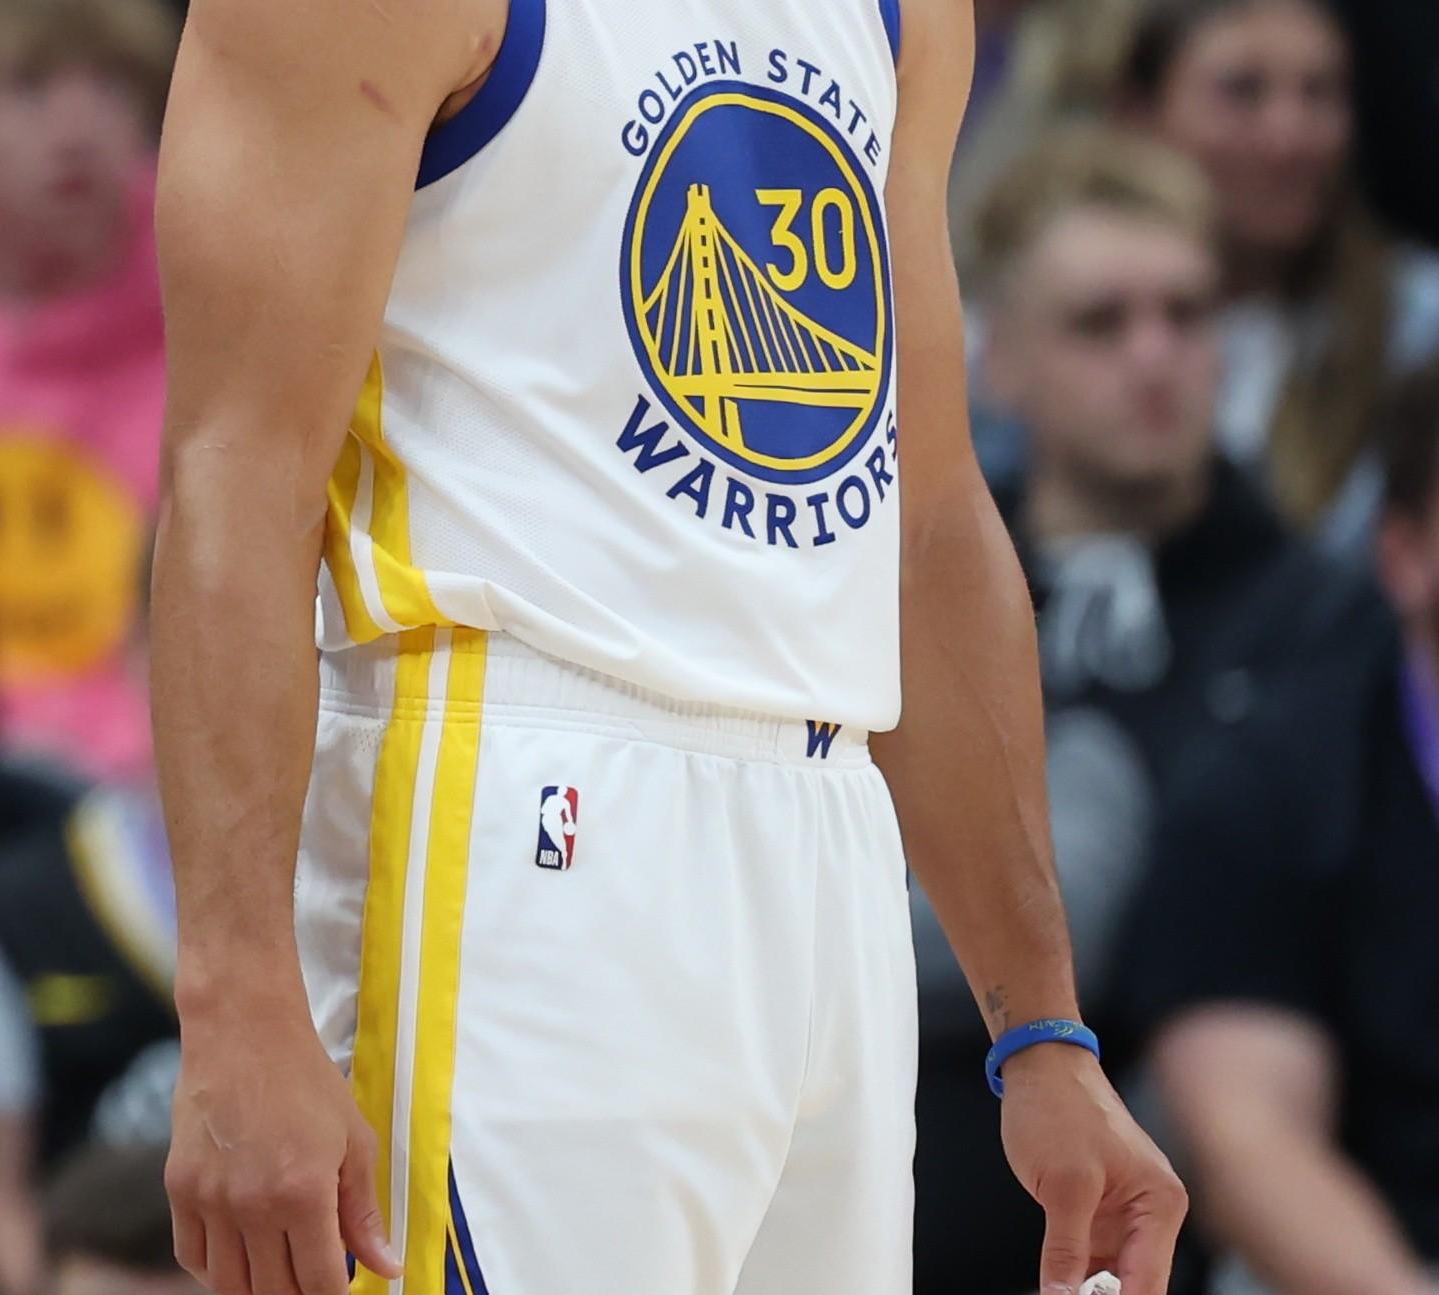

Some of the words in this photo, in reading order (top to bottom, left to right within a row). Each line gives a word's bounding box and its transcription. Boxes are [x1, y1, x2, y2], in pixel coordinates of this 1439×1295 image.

[621, 39, 741, 157] GOLDEN
[768, 48, 883, 167] STATE
[755, 188, 856, 291] 30
[615, 393, 897, 549] WARRIORS
[539, 848, 560, 867] NBA
